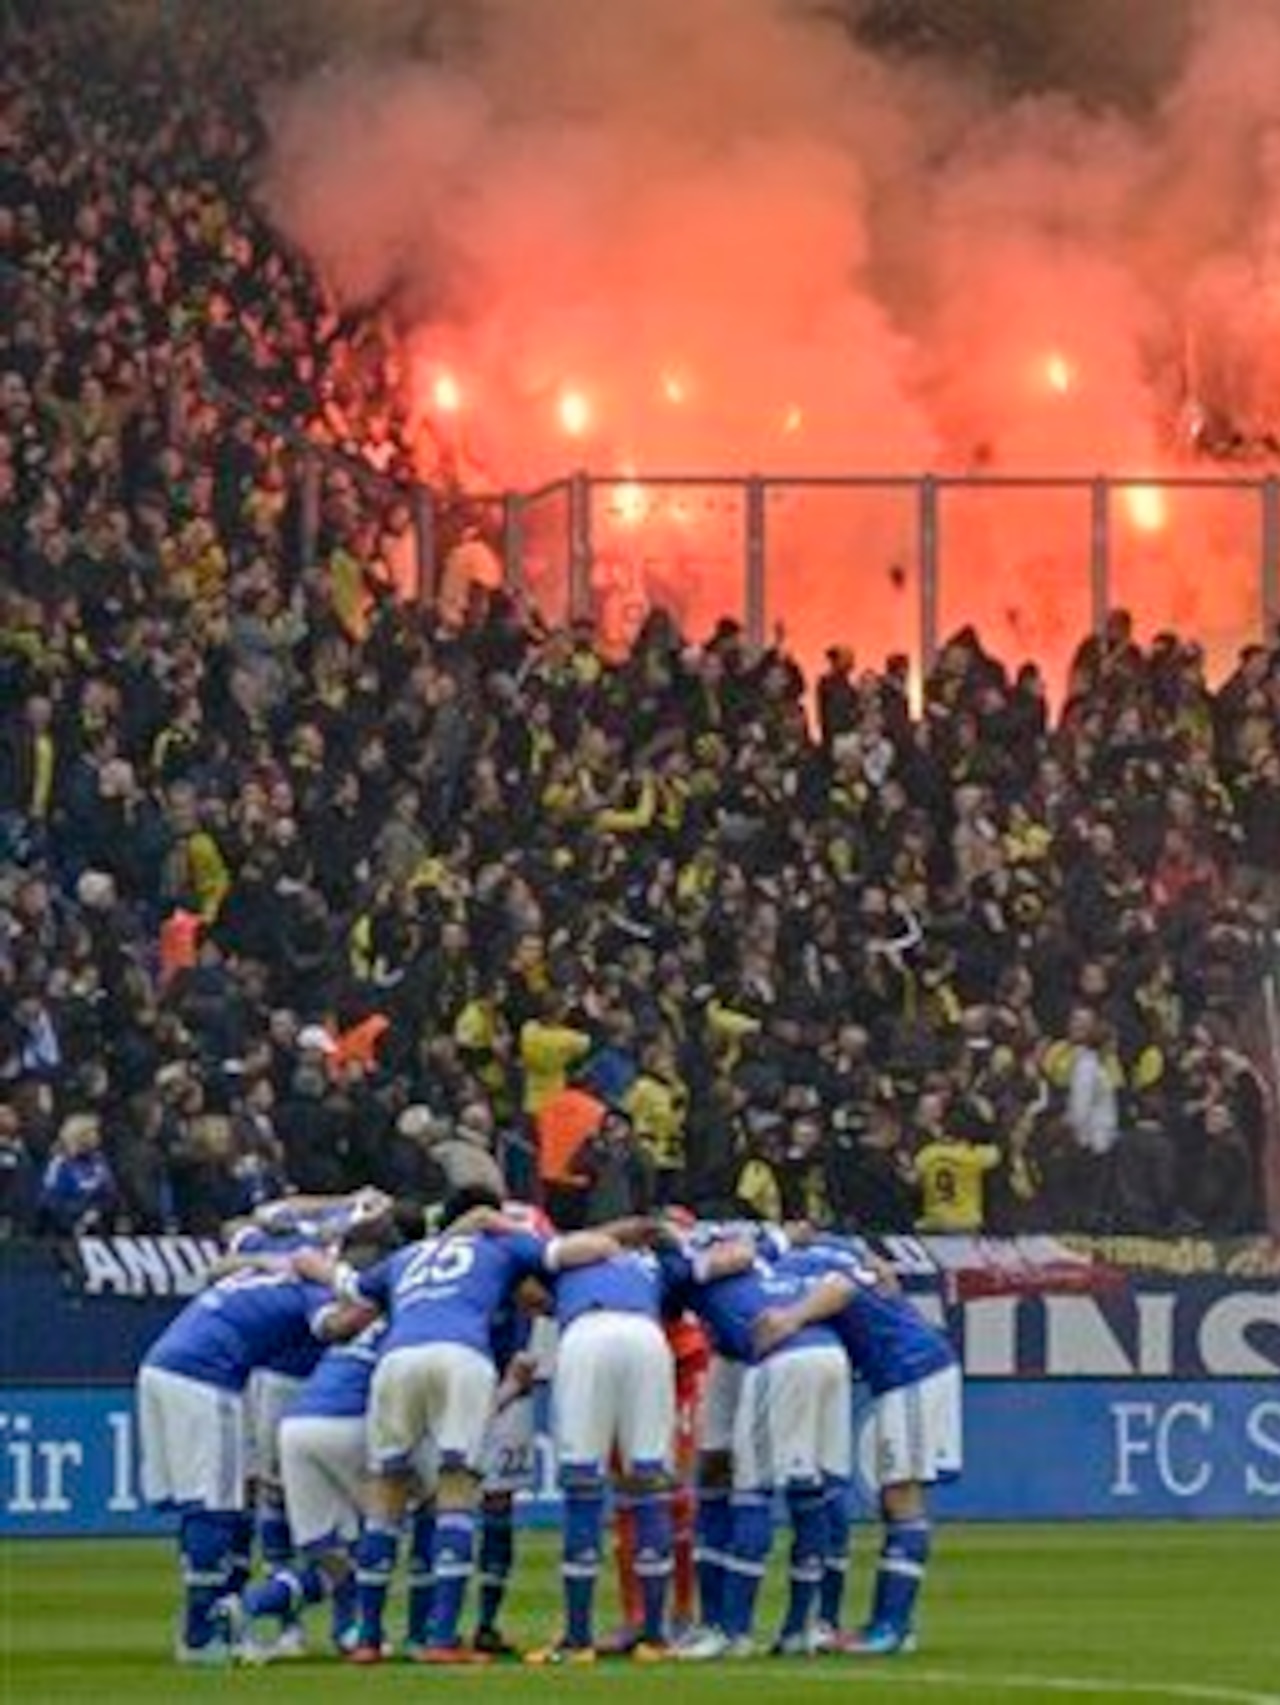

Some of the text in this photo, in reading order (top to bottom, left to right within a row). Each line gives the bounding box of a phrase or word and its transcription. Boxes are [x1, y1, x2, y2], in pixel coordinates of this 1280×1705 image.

[395, 1235, 476, 1292] 25
[0, 1413, 84, 1512] ir
[1109, 1402, 1214, 1496] FC
